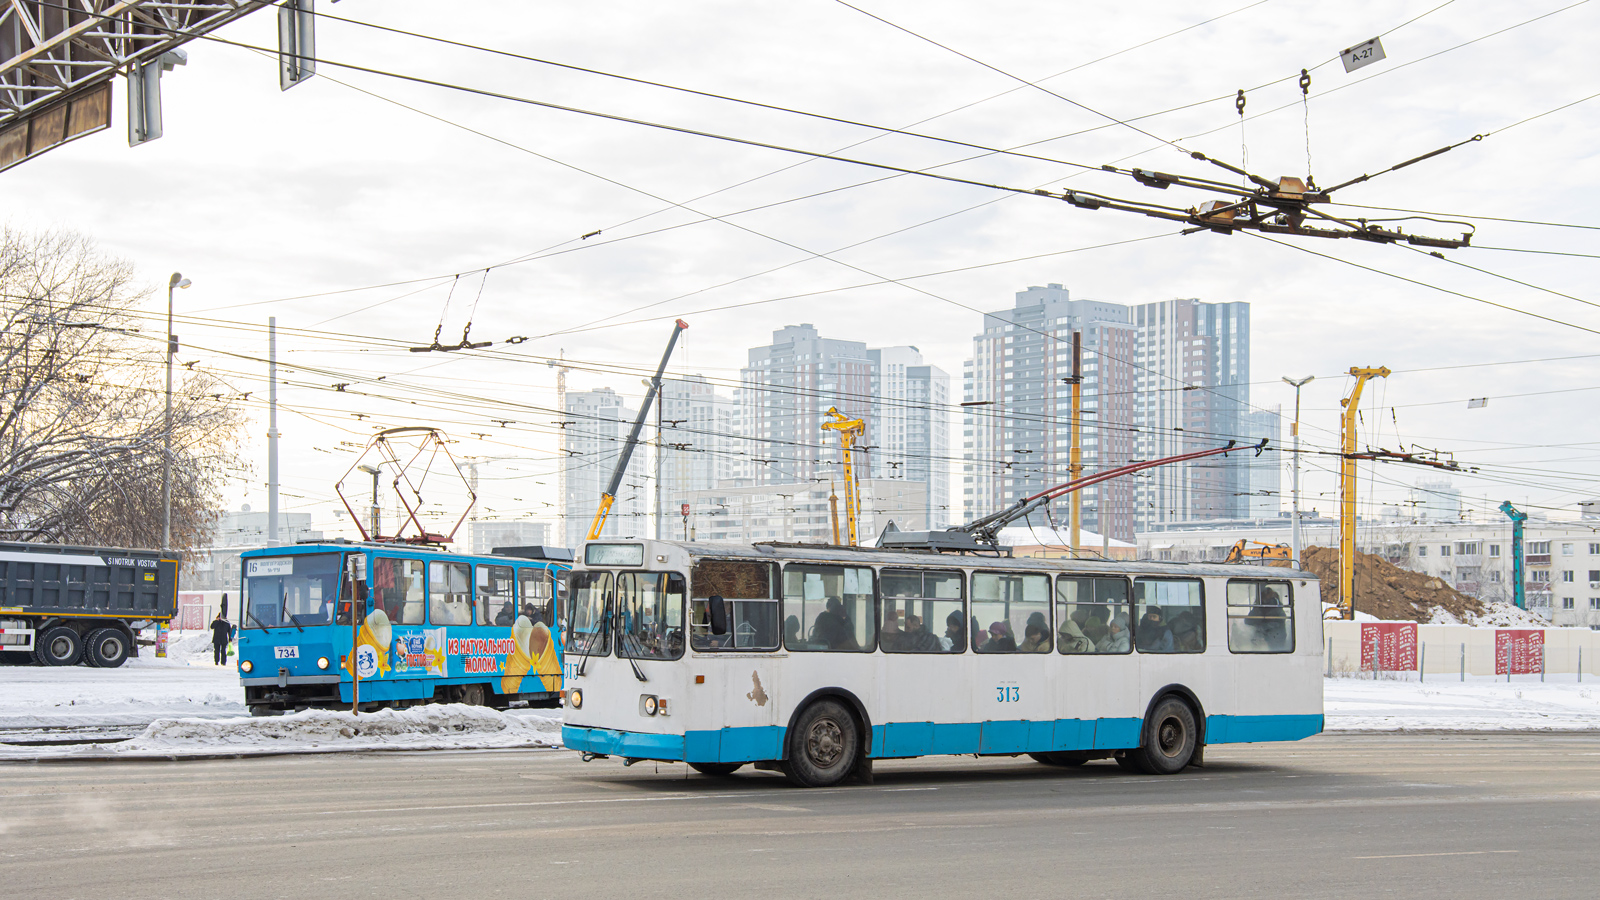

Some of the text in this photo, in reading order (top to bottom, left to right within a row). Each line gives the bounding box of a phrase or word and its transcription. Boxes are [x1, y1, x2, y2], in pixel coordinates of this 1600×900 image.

[108, 557, 158, 568] SINOTRUK VOSTOK
[249, 562, 258, 573] 16
[278, 649, 295, 658] 734
[448, 639, 516, 655] ИЗ НАТУРАЛЬНОГО
[465, 657, 498, 673] МОЛОКА
[996, 686, 1020, 703] 313
